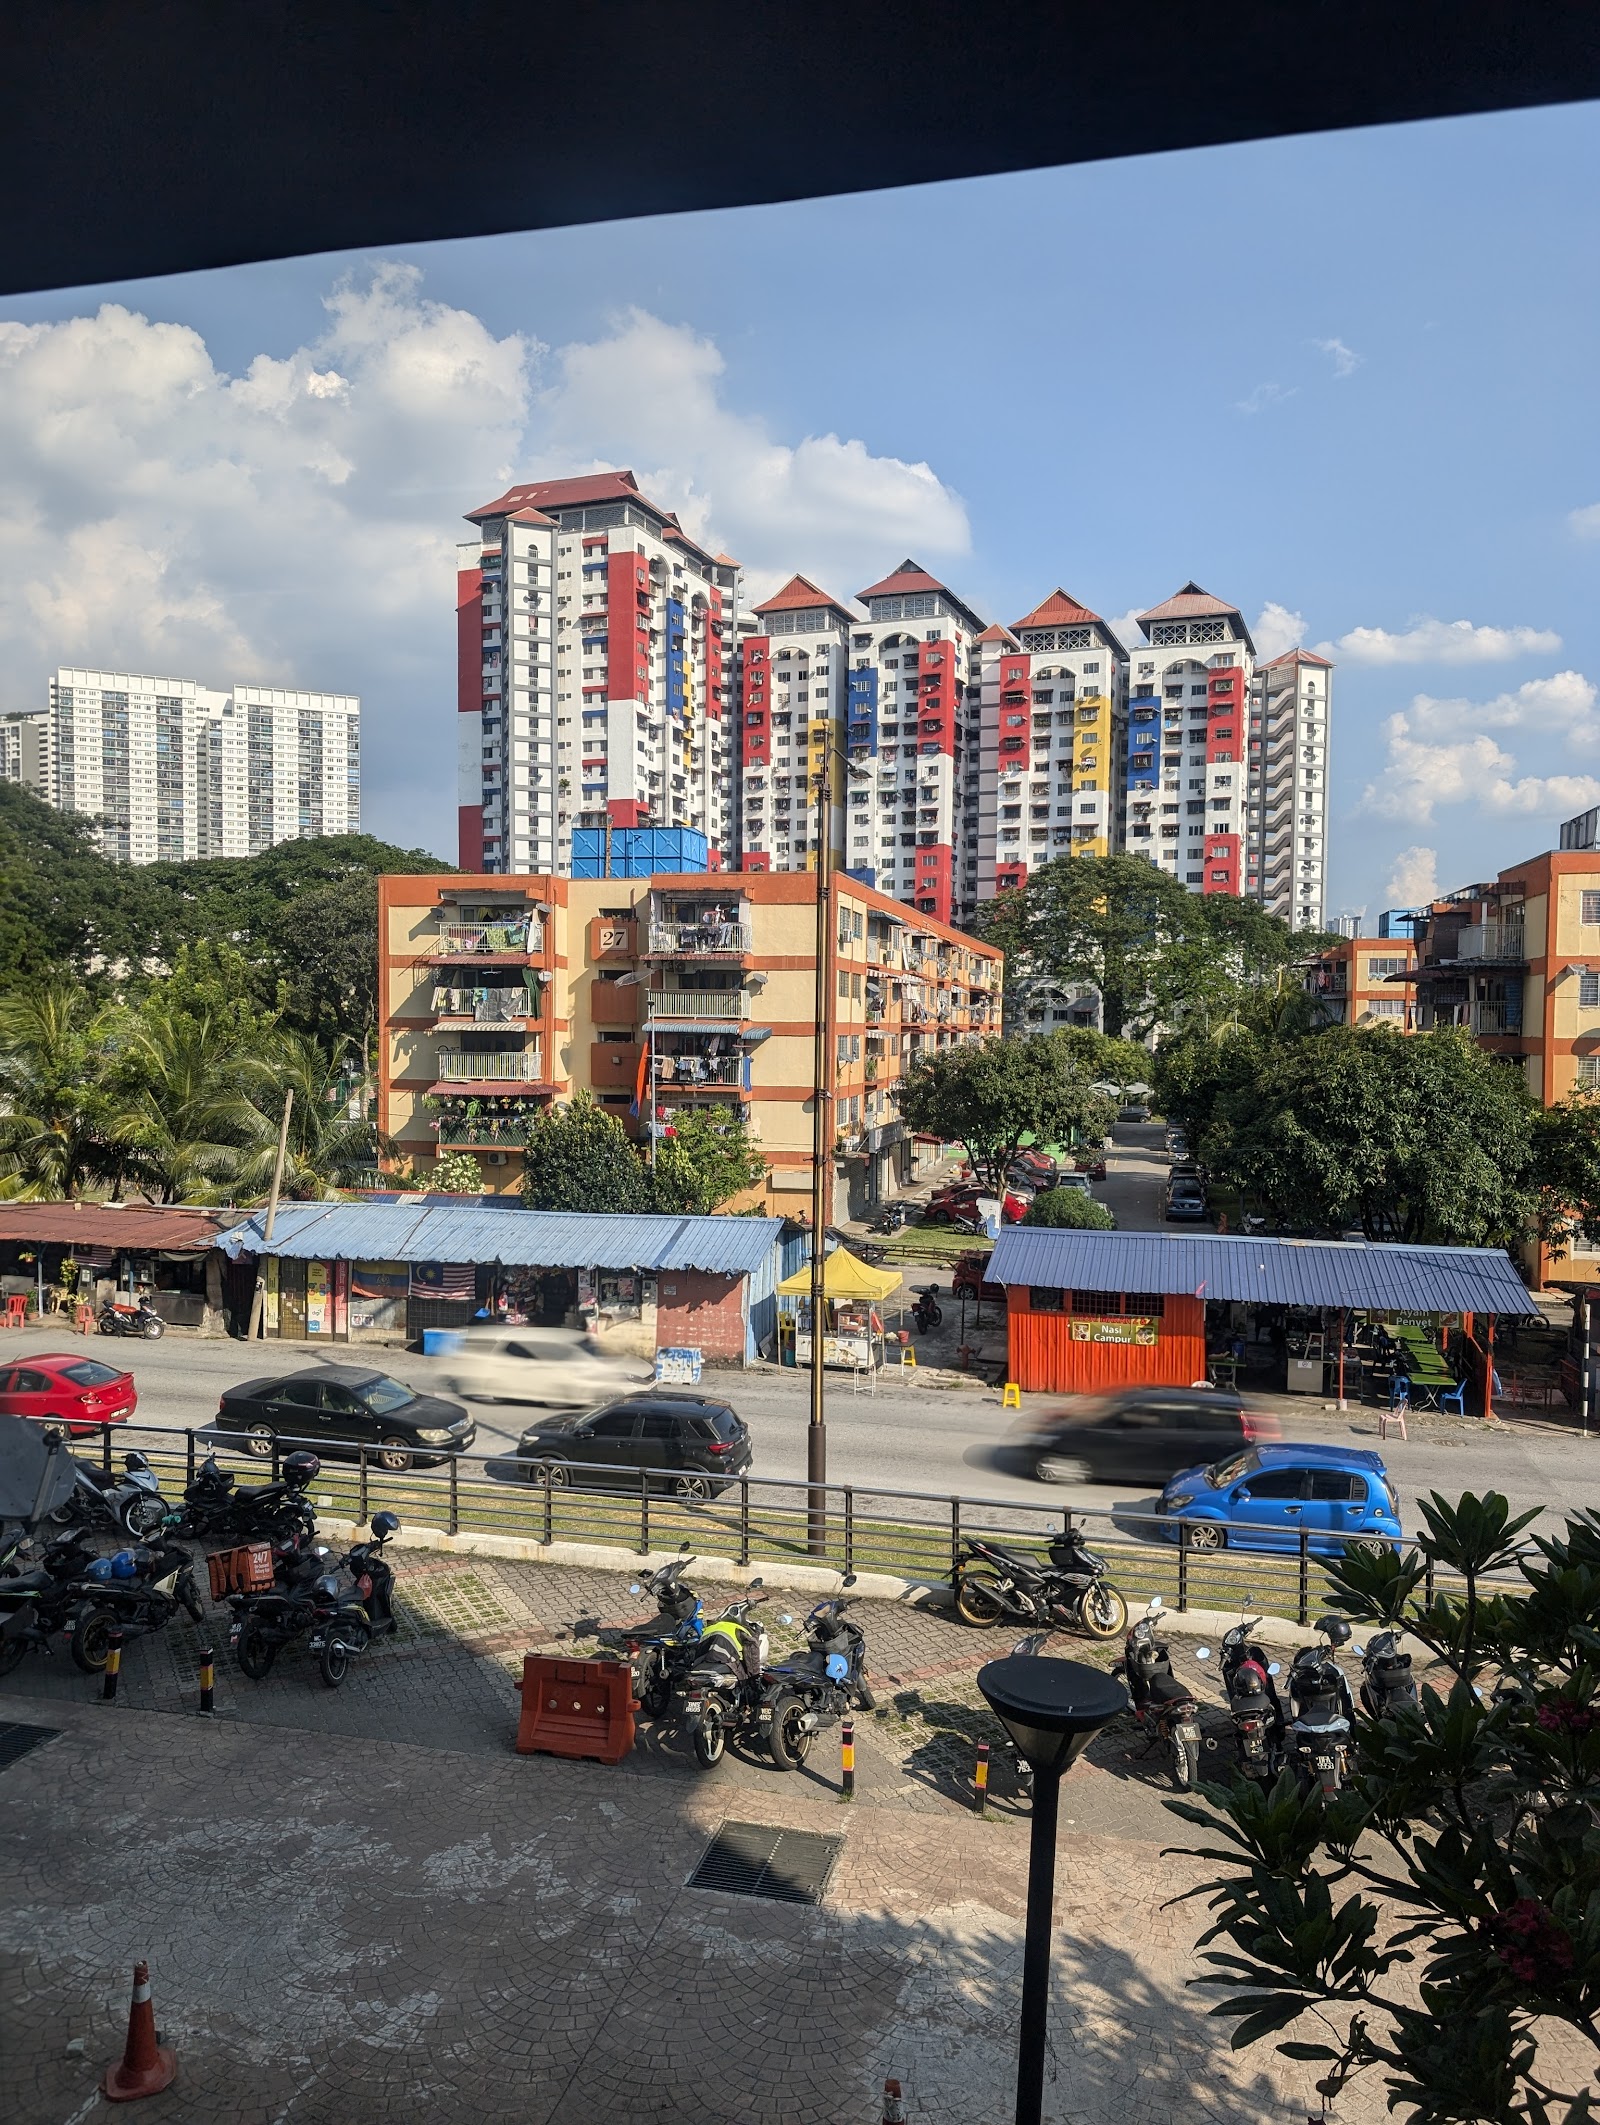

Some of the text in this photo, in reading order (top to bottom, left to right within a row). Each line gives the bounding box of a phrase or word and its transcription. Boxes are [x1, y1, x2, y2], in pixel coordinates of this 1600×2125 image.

[603, 931, 625, 946] 27
[1400, 1309, 1430, 1318] Ayam
[1396, 1317, 1432, 1329] Penyet
[1101, 1324, 1122, 1335] Nasi
[1093, 1333, 1132, 1344] Campur
[253, 1551, 268, 1564] 24/7
